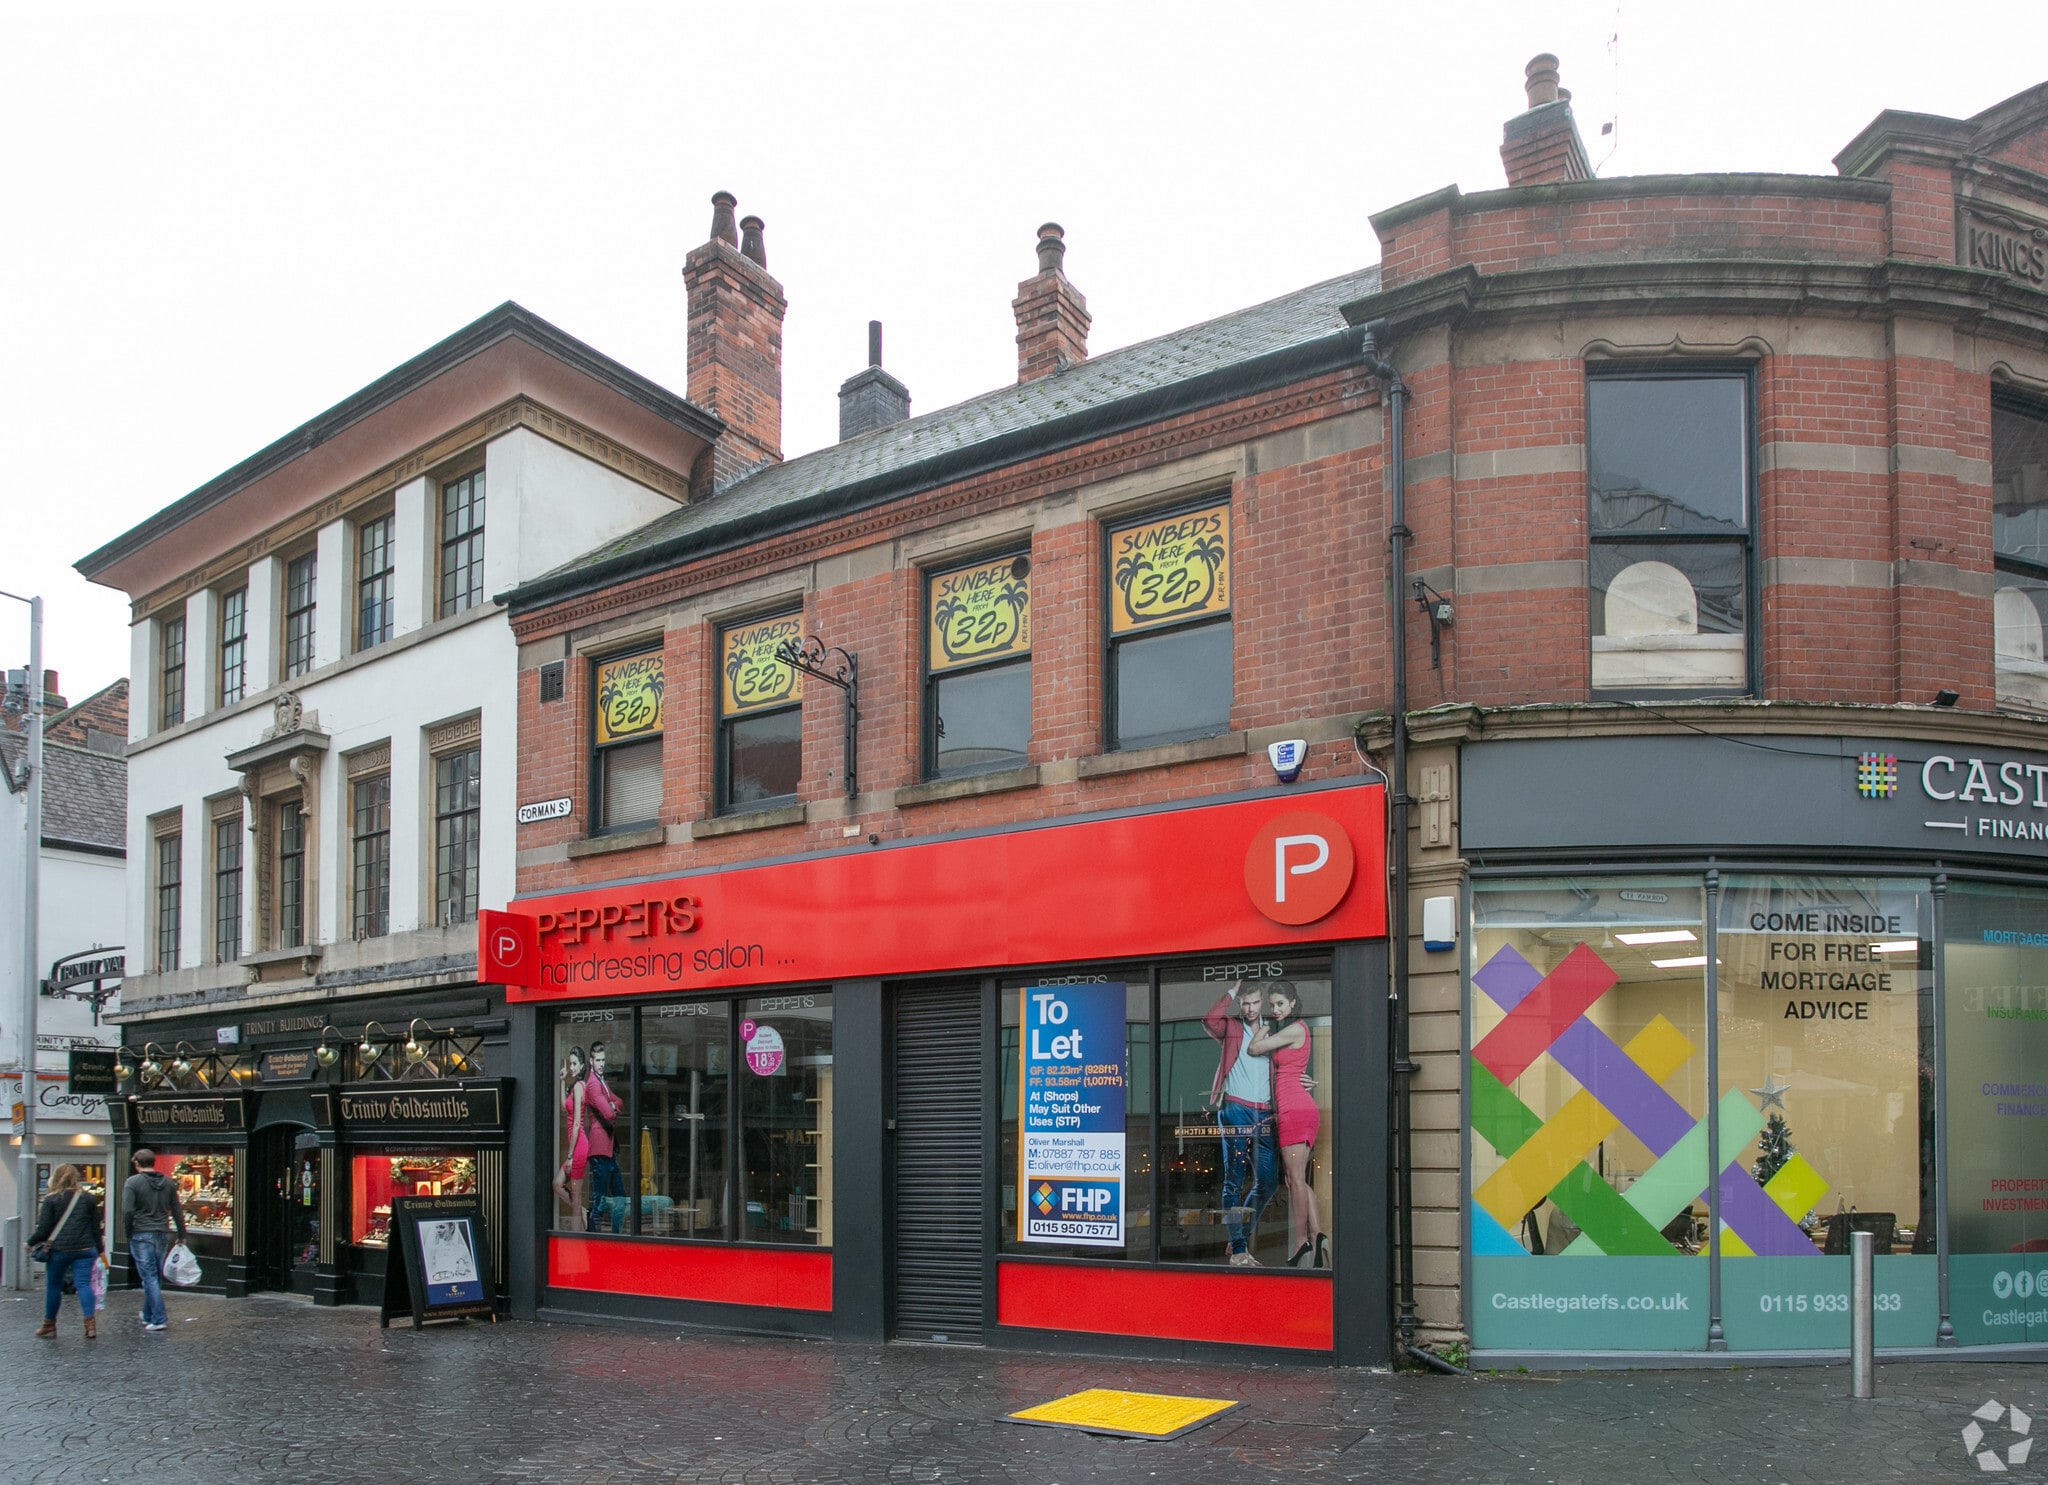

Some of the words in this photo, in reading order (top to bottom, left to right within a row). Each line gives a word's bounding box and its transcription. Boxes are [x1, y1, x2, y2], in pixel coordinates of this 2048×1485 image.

[1969, 228, 2046, 284] KINGS
[1119, 513, 1221, 554] SUNBEDS
[1152, 543, 1186, 561] HERE
[1160, 560, 1178, 569] FROM
[938, 565, 1011, 597] SUNBED
[966, 588, 995, 604] HERE
[729, 619, 800, 649] SUNBEDS
[752, 643, 775, 657] HERE
[602, 655, 663, 683] SUNBEDS
[622, 677, 642, 690] HERE
[521, 803, 556, 820] FORMAN
[1978, 818, 2048, 840] FINAN
[1275, 834, 1329, 902] P
[537, 895, 700, 948] PEPPERS
[1750, 913, 1819, 931] COME
[1827, 914, 1901, 933] INSIDE
[498, 937, 516, 960] P
[1771, 942, 1816, 961] FOR
[1824, 943, 1882, 962] FREE
[540, 946, 683, 986] hairdressing
[693, 939, 764, 972] salon
[1203, 961, 1284, 982] PEPPERS
[1761, 971, 1892, 991] MORTGAGE
[660, 1003, 709, 1018] PEPPERS
[760, 995, 815, 1010] PEPPERS
[1032, 993, 1069, 1025] To
[1784, 1001, 1868, 1020] ADVICE
[246, 1020, 276, 1035] TRINITY
[280, 1015, 324, 1032] BUILDINGS
[570, 1009, 615, 1023] PEPPERS
[744, 1023, 753, 1037] P
[1032, 1029, 1083, 1060] Let
[1030, 1066, 1045, 1075] GF:
[1029, 1078, 1043, 1086] FF:
[1044, 1090, 1079, 1102] (Shops)
[136, 1106, 170, 1124] Trinity
[170, 1104, 225, 1125] Goldsmiths
[340, 1098, 387, 1123] Trinity
[389, 1096, 470, 1123] Goldsmiths
[1029, 1104, 1049, 1115] May
[1051, 1104, 1070, 1114] Suit
[1073, 1104, 1101, 1114] Other
[1997, 1103, 2047, 1116] FINANCE
[1029, 1117, 1053, 1126] Uses
[1056, 1116, 1080, 1128] (STP)
[1028, 1138, 1049, 1146] Oliver
[1052, 1138, 1084, 1146] Marshall
[1028, 1149, 1040, 1158] M:
[1042, 1149, 1073, 1159] 07887
[1077, 1149, 1095, 1159] 787
[1100, 1150, 1120, 1159] 885
[403, 1200, 432, 1209] Trinity
[434, 1199, 477, 1208] Goldsmiths
[1062, 1188, 1112, 1212] FHP
[1061, 1212, 1117, 1222] www.fhp.co.uk
[1033, 1222, 1058, 1233] 0115
[1061, 1223, 1083, 1234] 950
[1085, 1224, 1113, 1236] 7577
[1491, 1292, 1689, 1313] Castlegatefs.co.uk
[1760, 1294, 1807, 1312] 0115
[1813, 1294, 1848, 1312] 933
